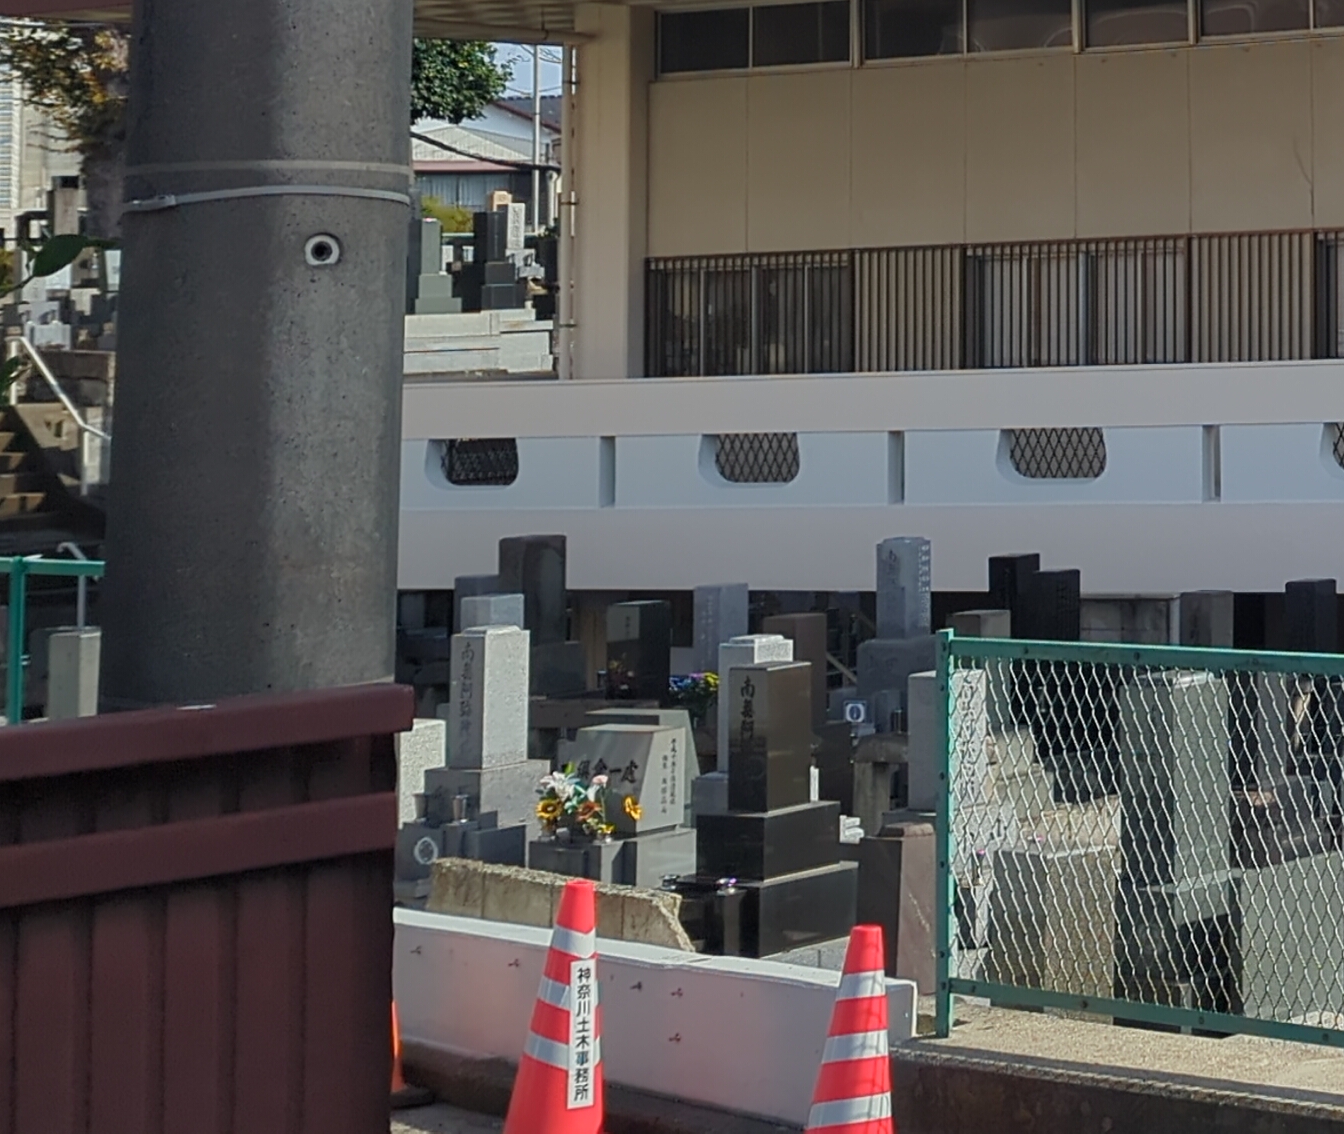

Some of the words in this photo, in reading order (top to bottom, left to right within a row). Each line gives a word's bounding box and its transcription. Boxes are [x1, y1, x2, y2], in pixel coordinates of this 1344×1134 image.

[573, 967, 592, 1102] 神奈川土木事務所
